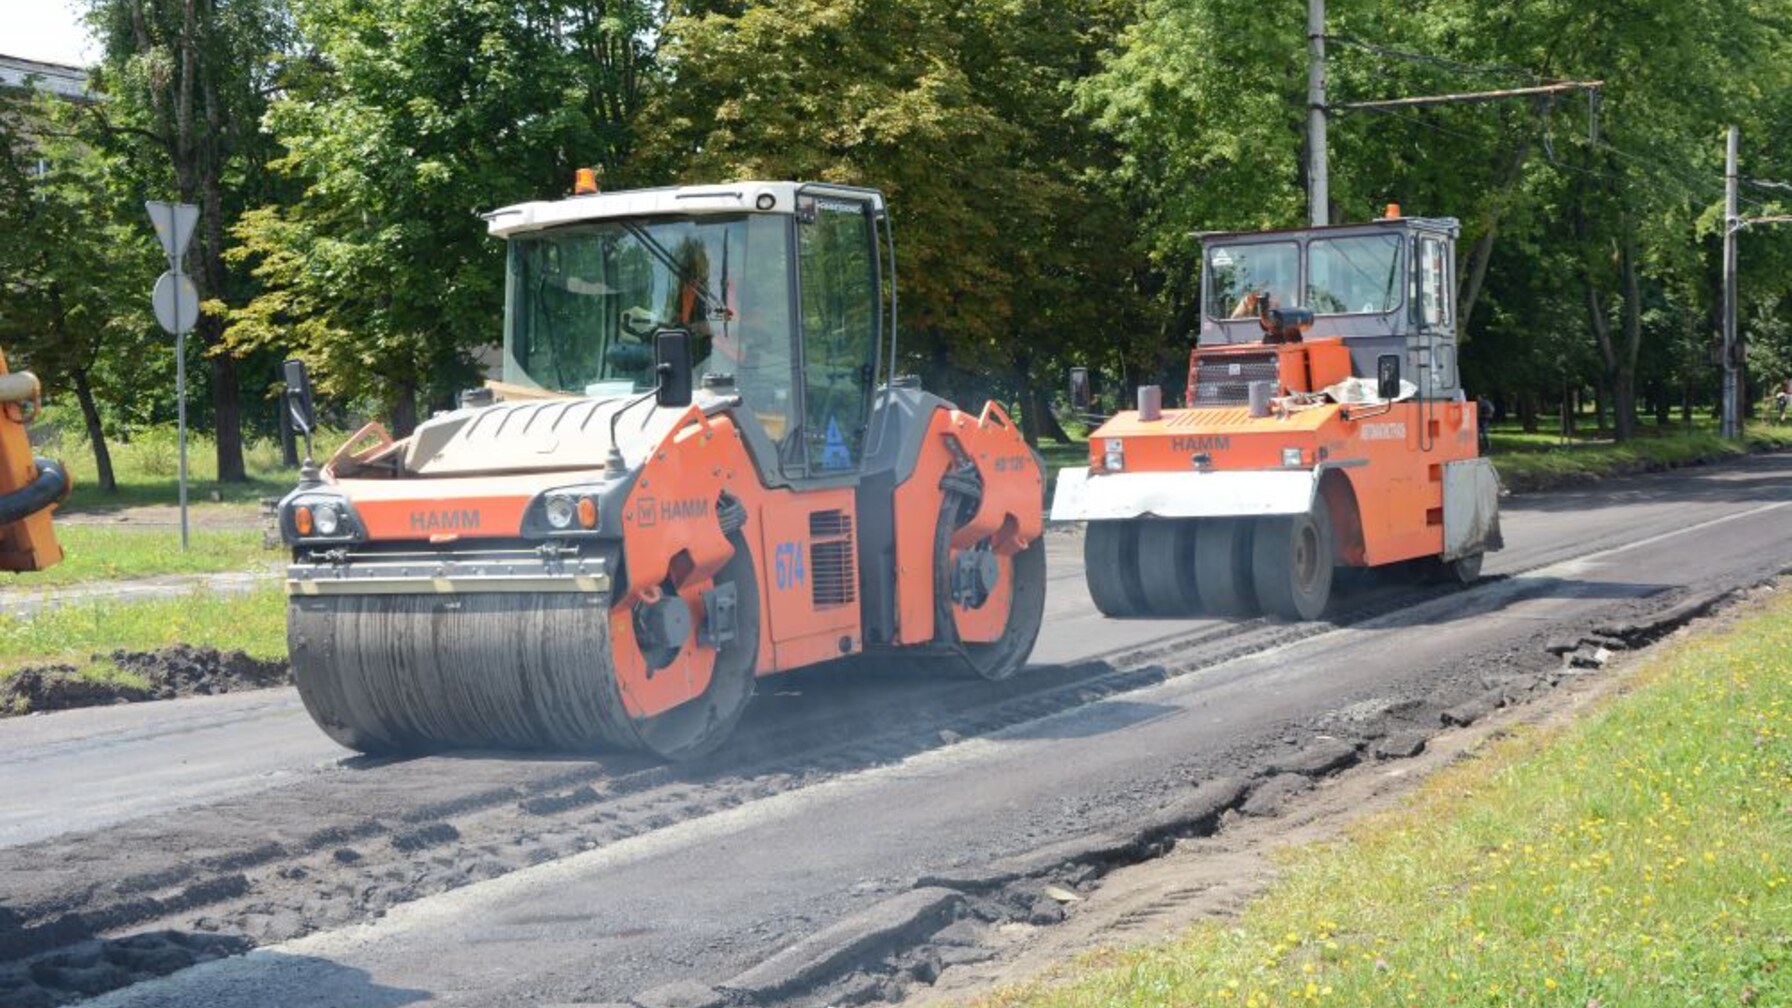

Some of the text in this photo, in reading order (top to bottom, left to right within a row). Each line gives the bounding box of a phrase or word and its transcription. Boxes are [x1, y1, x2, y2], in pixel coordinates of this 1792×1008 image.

[1172, 435, 1231, 452] HAMM
[410, 509, 480, 531] HAMM
[660, 498, 709, 521] HAMM
[775, 542, 805, 590] 674
